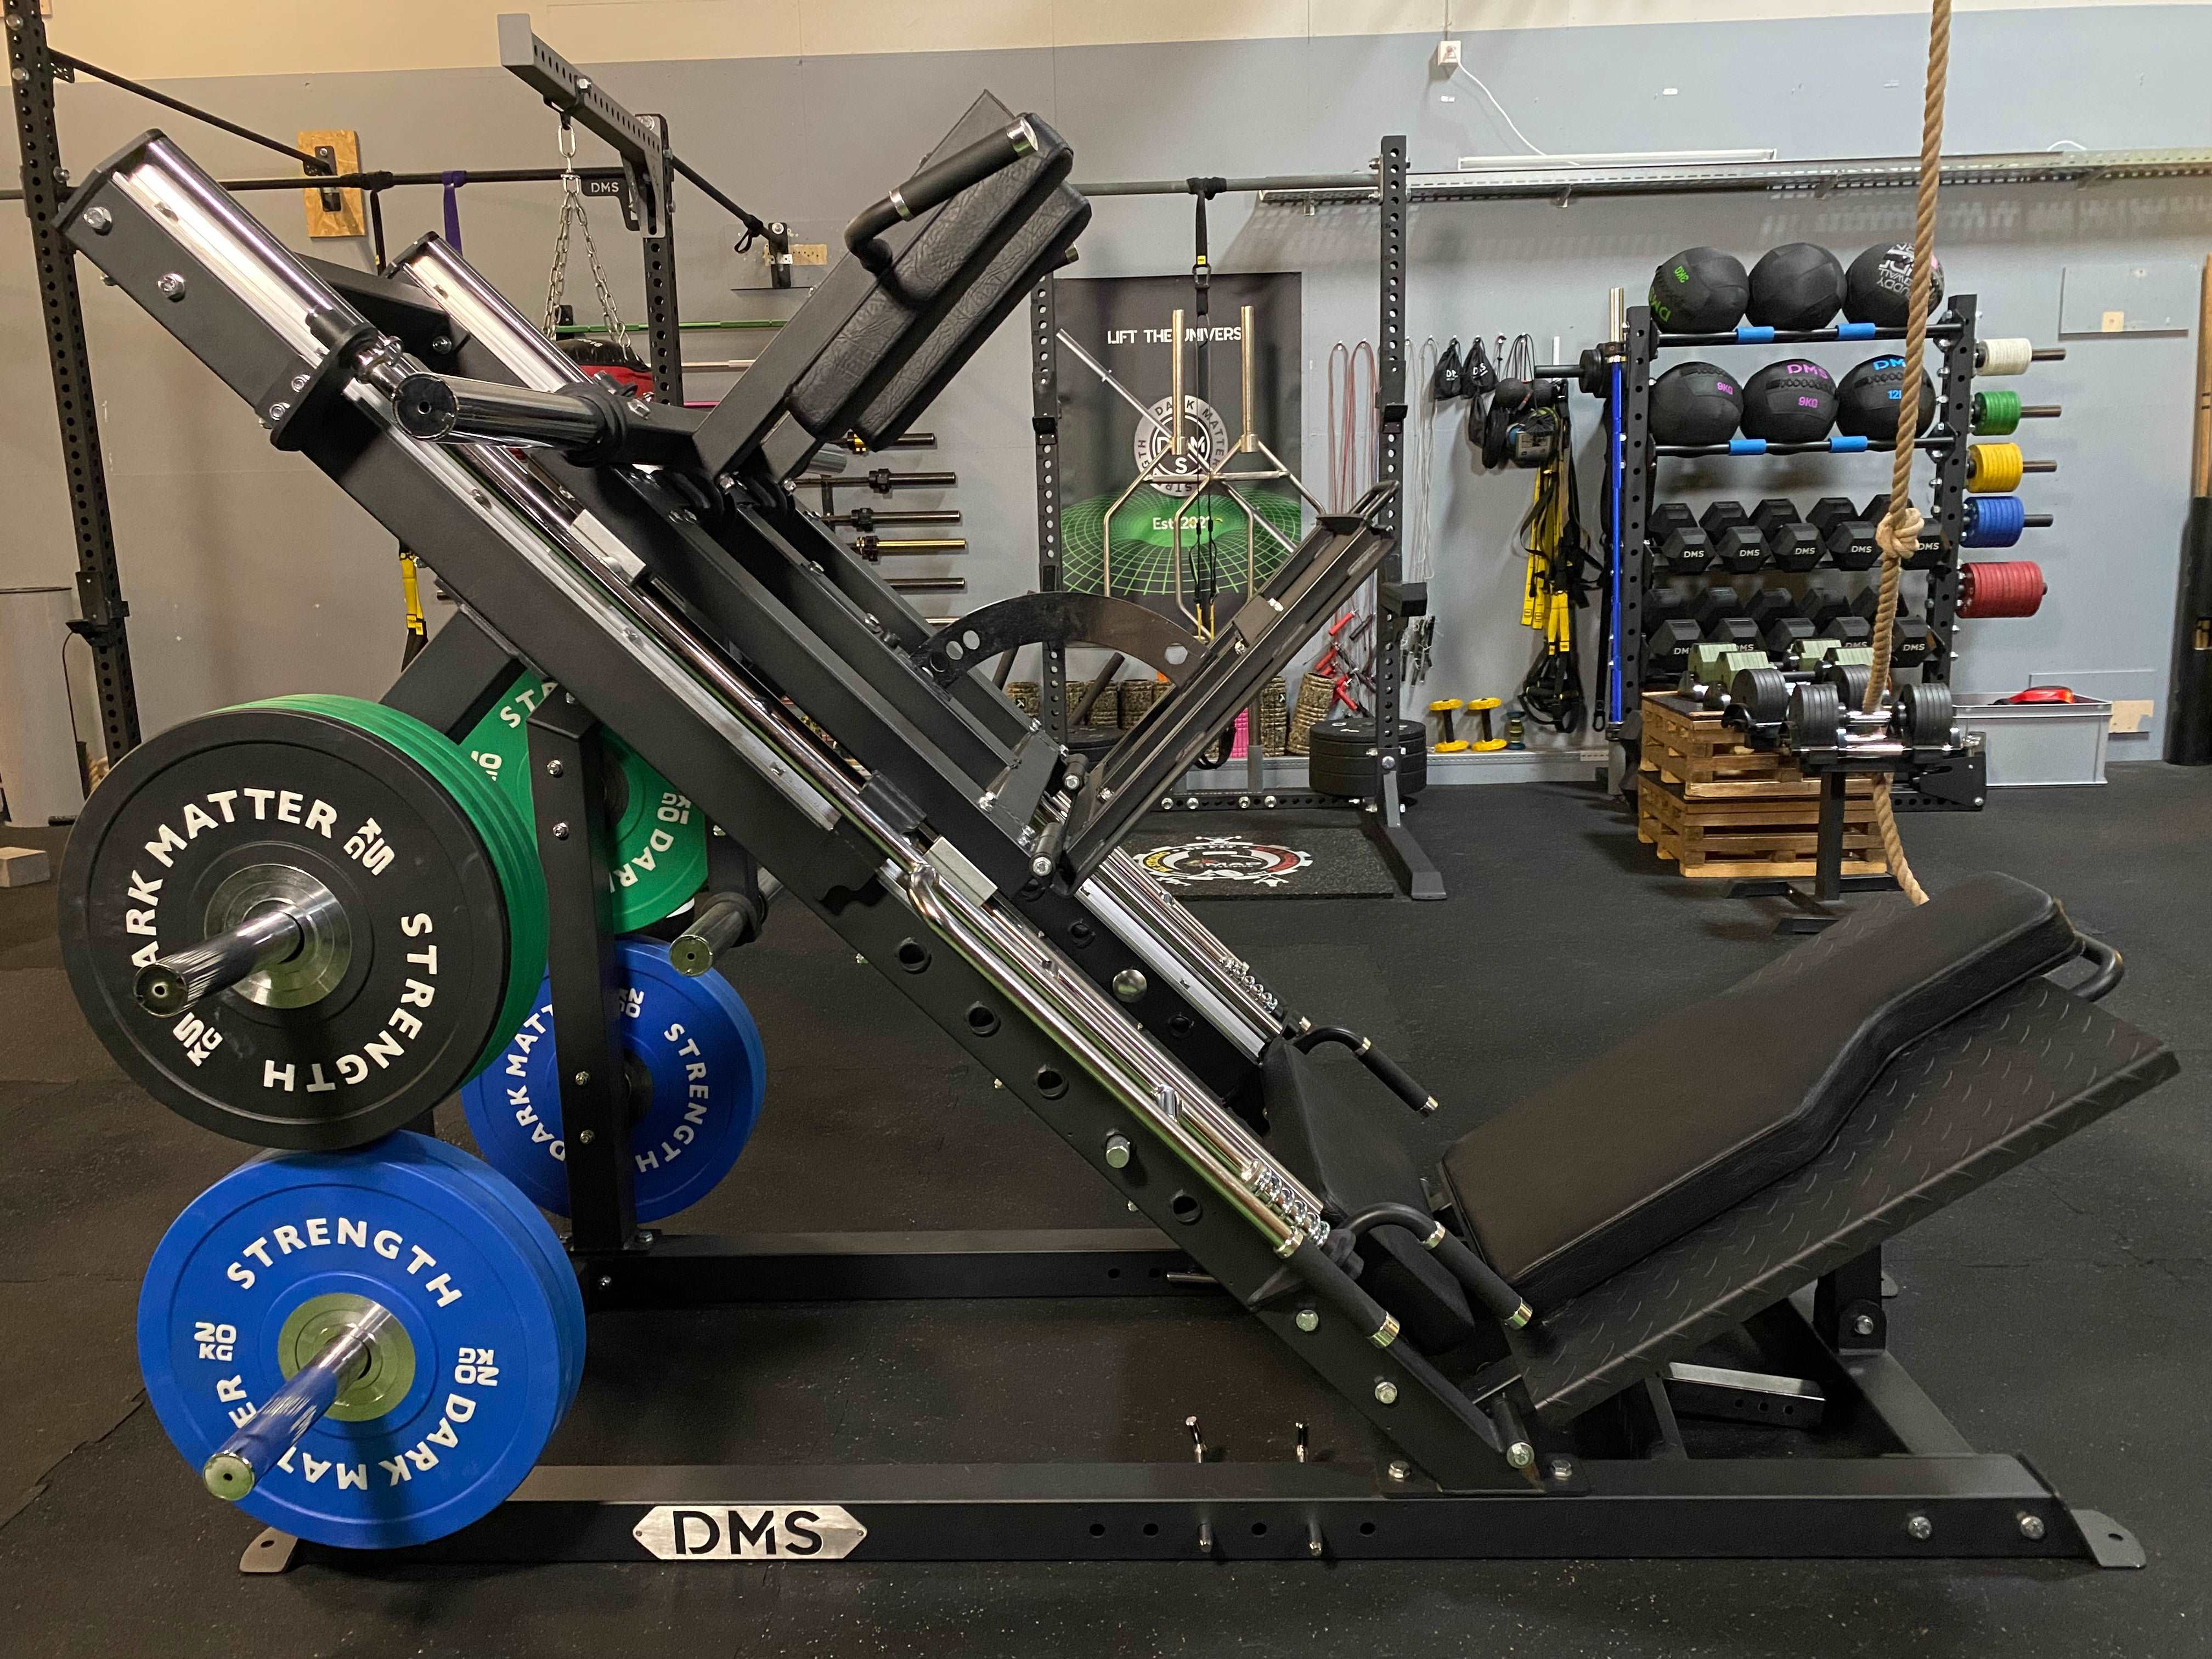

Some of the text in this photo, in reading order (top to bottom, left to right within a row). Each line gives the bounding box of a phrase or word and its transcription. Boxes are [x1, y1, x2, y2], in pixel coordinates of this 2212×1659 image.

[591, 182, 619, 193] DMS
[1877, 276, 1910, 297] UDDY
[1107, 326, 1242, 345] LIFT THE NIVERS
[1472, 363, 1486, 375] DS
[1787, 364, 1829, 379] DMS
[1873, 358, 1906, 370] DM
[1717, 381, 1733, 395] 9KG
[1887, 390, 1902, 399] 12
[1155, 400, 1195, 416] DAK
[1798, 396, 1818, 408] 9KG
[1918, 542, 1940, 550] DMS
[1903, 644, 1926, 652] DMS
[661, 792, 692, 809] KG
[657, 806, 690, 825] 10
[343, 817, 382, 860] KG
[609, 828, 675, 894] DAR
[126, 787, 338, 968] ARK MATTER
[263, 912, 438, 1093] STRENGTH
[625, 988, 645, 1018] 20
[187, 1026, 223, 1067] KG
[505, 1003, 566, 1161] DARK MAT
[635, 1022, 709, 1173] STRENGTH
[227, 1217, 463, 1308] STRENGTH
[194, 1322, 237, 1345] 20
[199, 1343, 233, 1361] KG
[458, 1347, 494, 1365] KG
[454, 1365, 500, 1387] 20
[216, 1374, 477, 1491] DARK MATER
[673, 1510, 823, 1556] DMS
